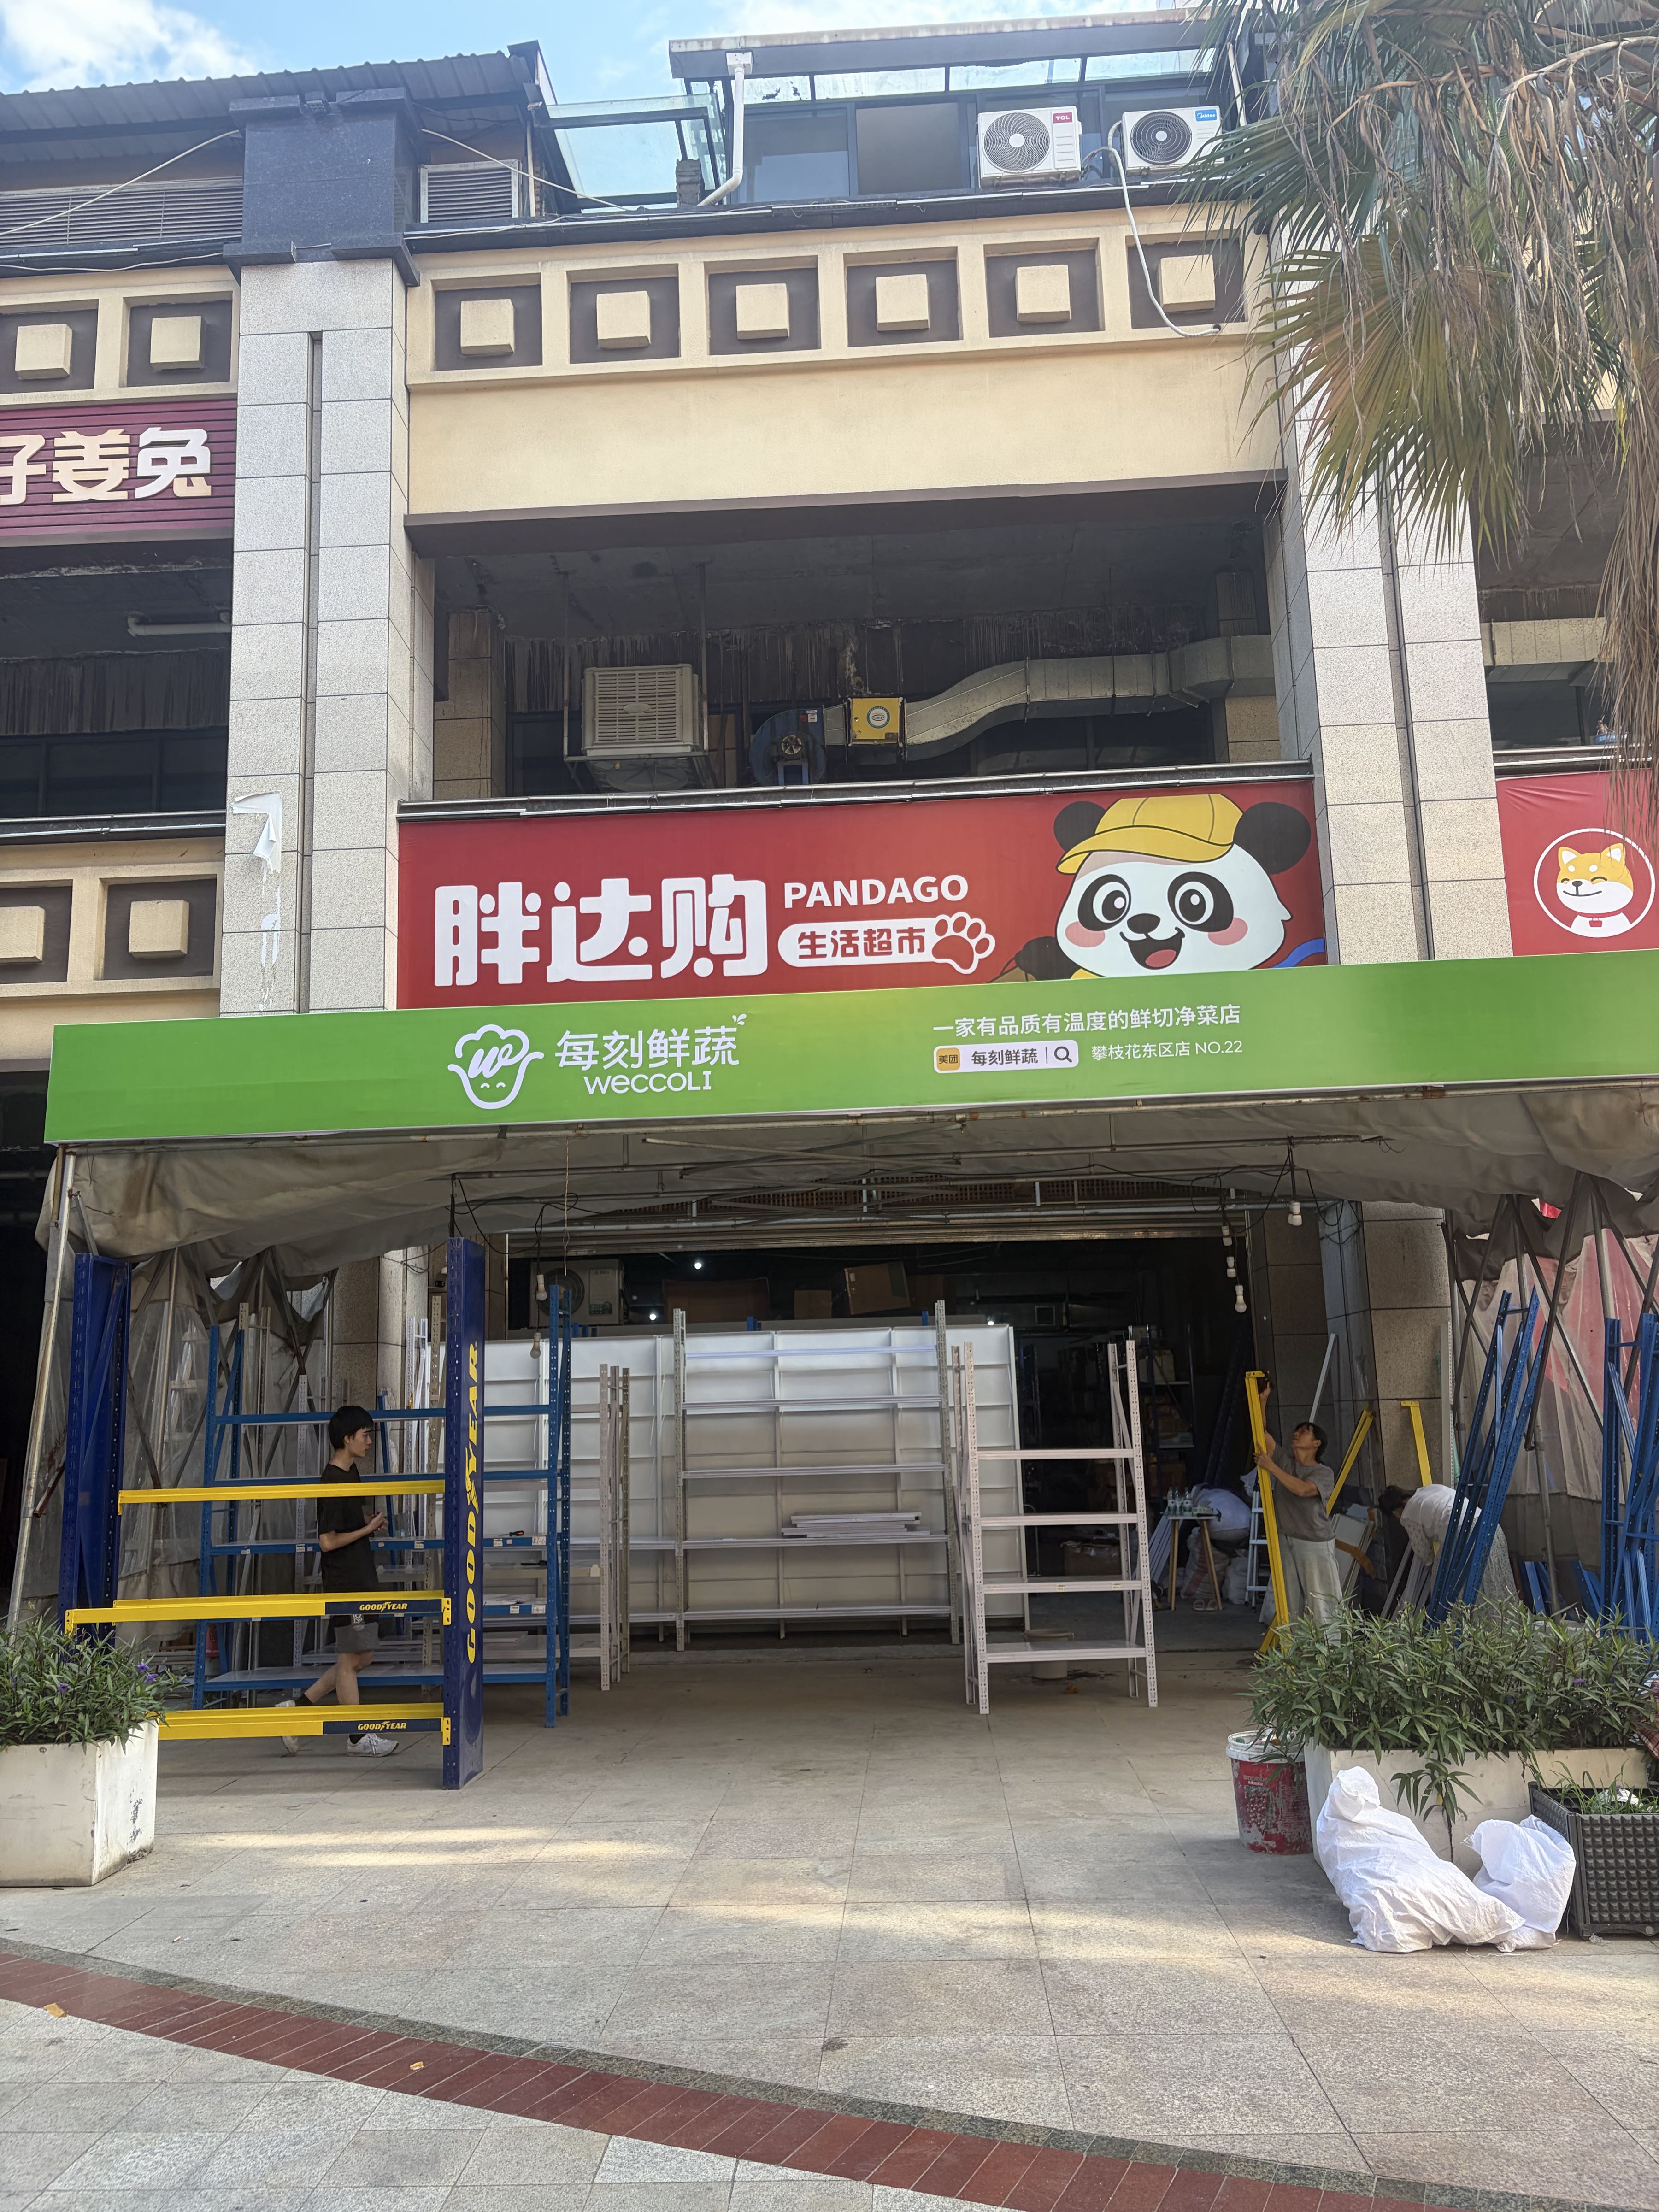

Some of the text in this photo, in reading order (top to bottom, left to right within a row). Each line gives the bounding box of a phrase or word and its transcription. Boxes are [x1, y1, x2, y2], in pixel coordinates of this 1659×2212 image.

[784, 874, 969, 909] PANDAGO
[434, 873, 768, 987] 胖达购
[798, 926, 926, 959] 生活超市
[933, 1003, 1241, 1037] 一家有品质有温度的鲜切净菜店
[554, 1025, 740, 1071] 每刻鲜蔬
[938, 1054, 959, 1065] 美团
[971, 1047, 1039, 1066] 每刻鲜蔬
[1091, 1040, 1243, 1061] 攀枝花东区店 NO.22
[465, 1342, 479, 1664] GOODYEAR
[359, 1601, 408, 1612] GOODYEAR
[357, 1721, 406, 1731] GOODYEAR
